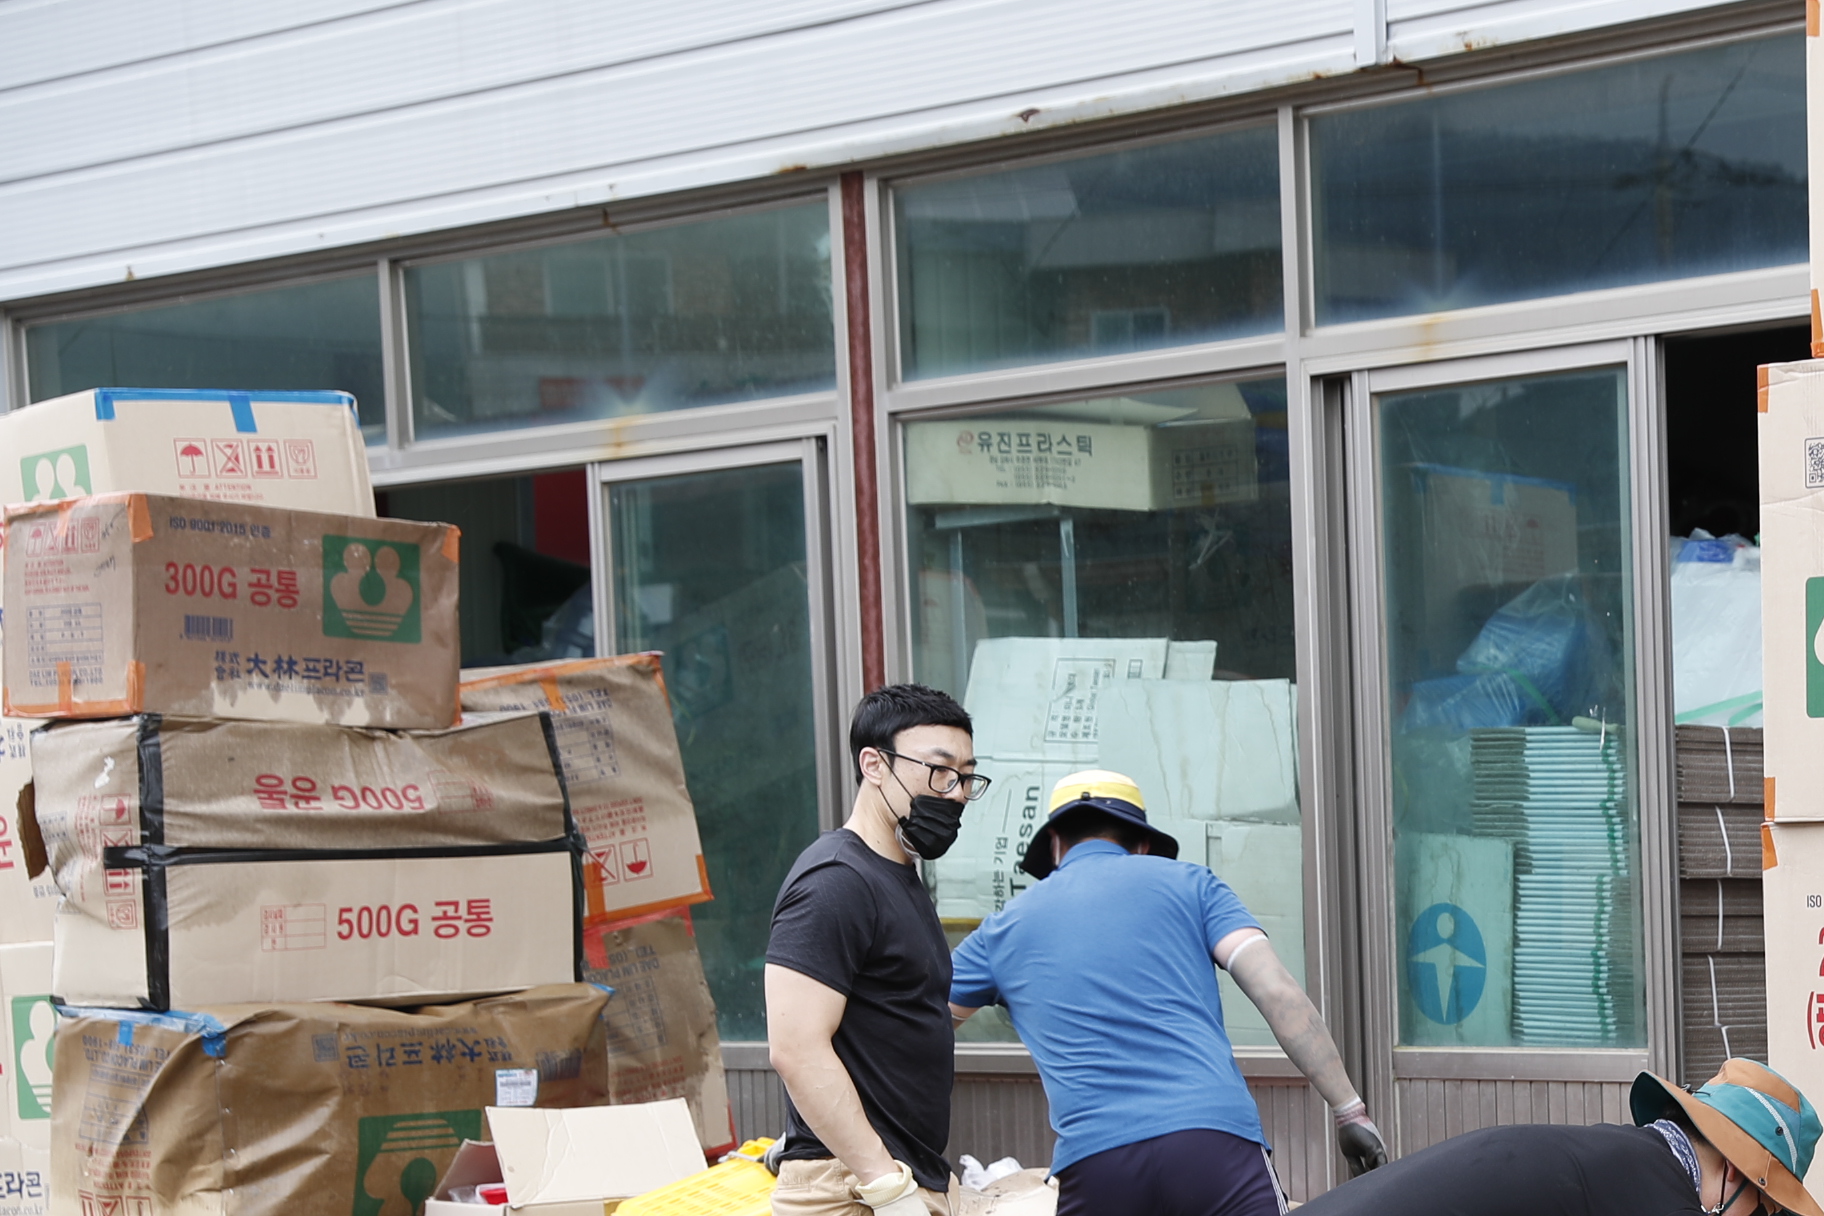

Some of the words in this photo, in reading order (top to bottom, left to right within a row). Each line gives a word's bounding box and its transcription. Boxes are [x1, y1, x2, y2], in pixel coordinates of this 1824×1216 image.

[169, 516, 187, 530] ISO
[164, 561, 238, 601] 300G
[248, 567, 301, 609] 공통
[246, 651, 365, 684] 大林프라콘
[1806, 894, 1822, 909] ISO
[336, 905, 420, 943] 500G
[432, 897, 494, 940] 공통
